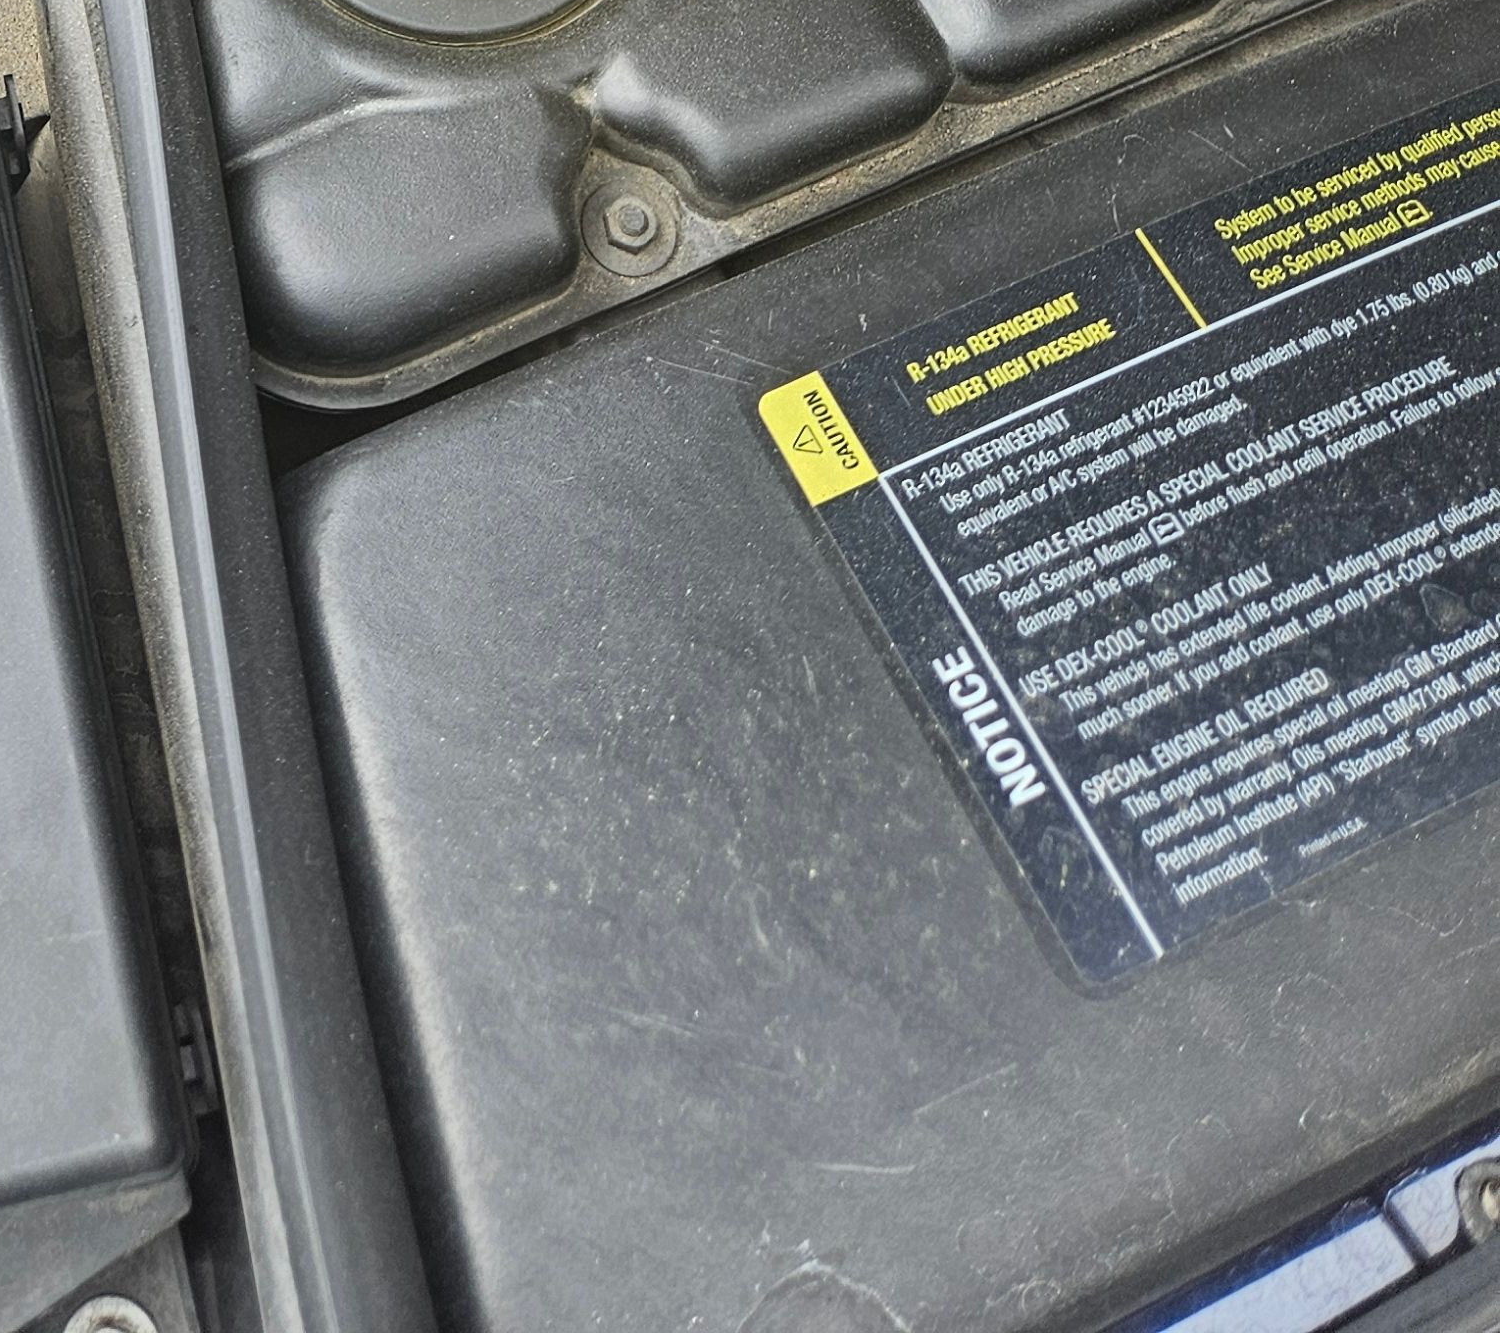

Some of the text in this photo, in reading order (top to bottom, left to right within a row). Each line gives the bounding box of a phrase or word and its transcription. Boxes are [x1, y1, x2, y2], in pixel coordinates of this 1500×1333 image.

[1215, 123, 1464, 239] System to be serviced by qualified
[1232, 159, 1461, 266] Improper service methods may
[1250, 211, 1401, 289] See Service Manual
[907, 292, 1078, 383] R-134a REFRIGERANT
[926, 318, 1116, 415] UNDER HIGH PRESSURE
[801, 389, 859, 471] CAUTION
[902, 409, 1070, 501] R-134a REFRIGERANT
[958, 356, 1456, 596] THIS VEHICLE REQUIRES A SPECIAL COOLANT SERVICE PROCEDURE
[1019, 665, 1059, 698] USE
[1151, 582, 1228, 635] COOLANT
[1229, 562, 1272, 598] ONLY
[934, 645, 1046, 806] NOTICE
[1082, 668, 1329, 804] SPECIAL ENGINE OIL REQUIRED
